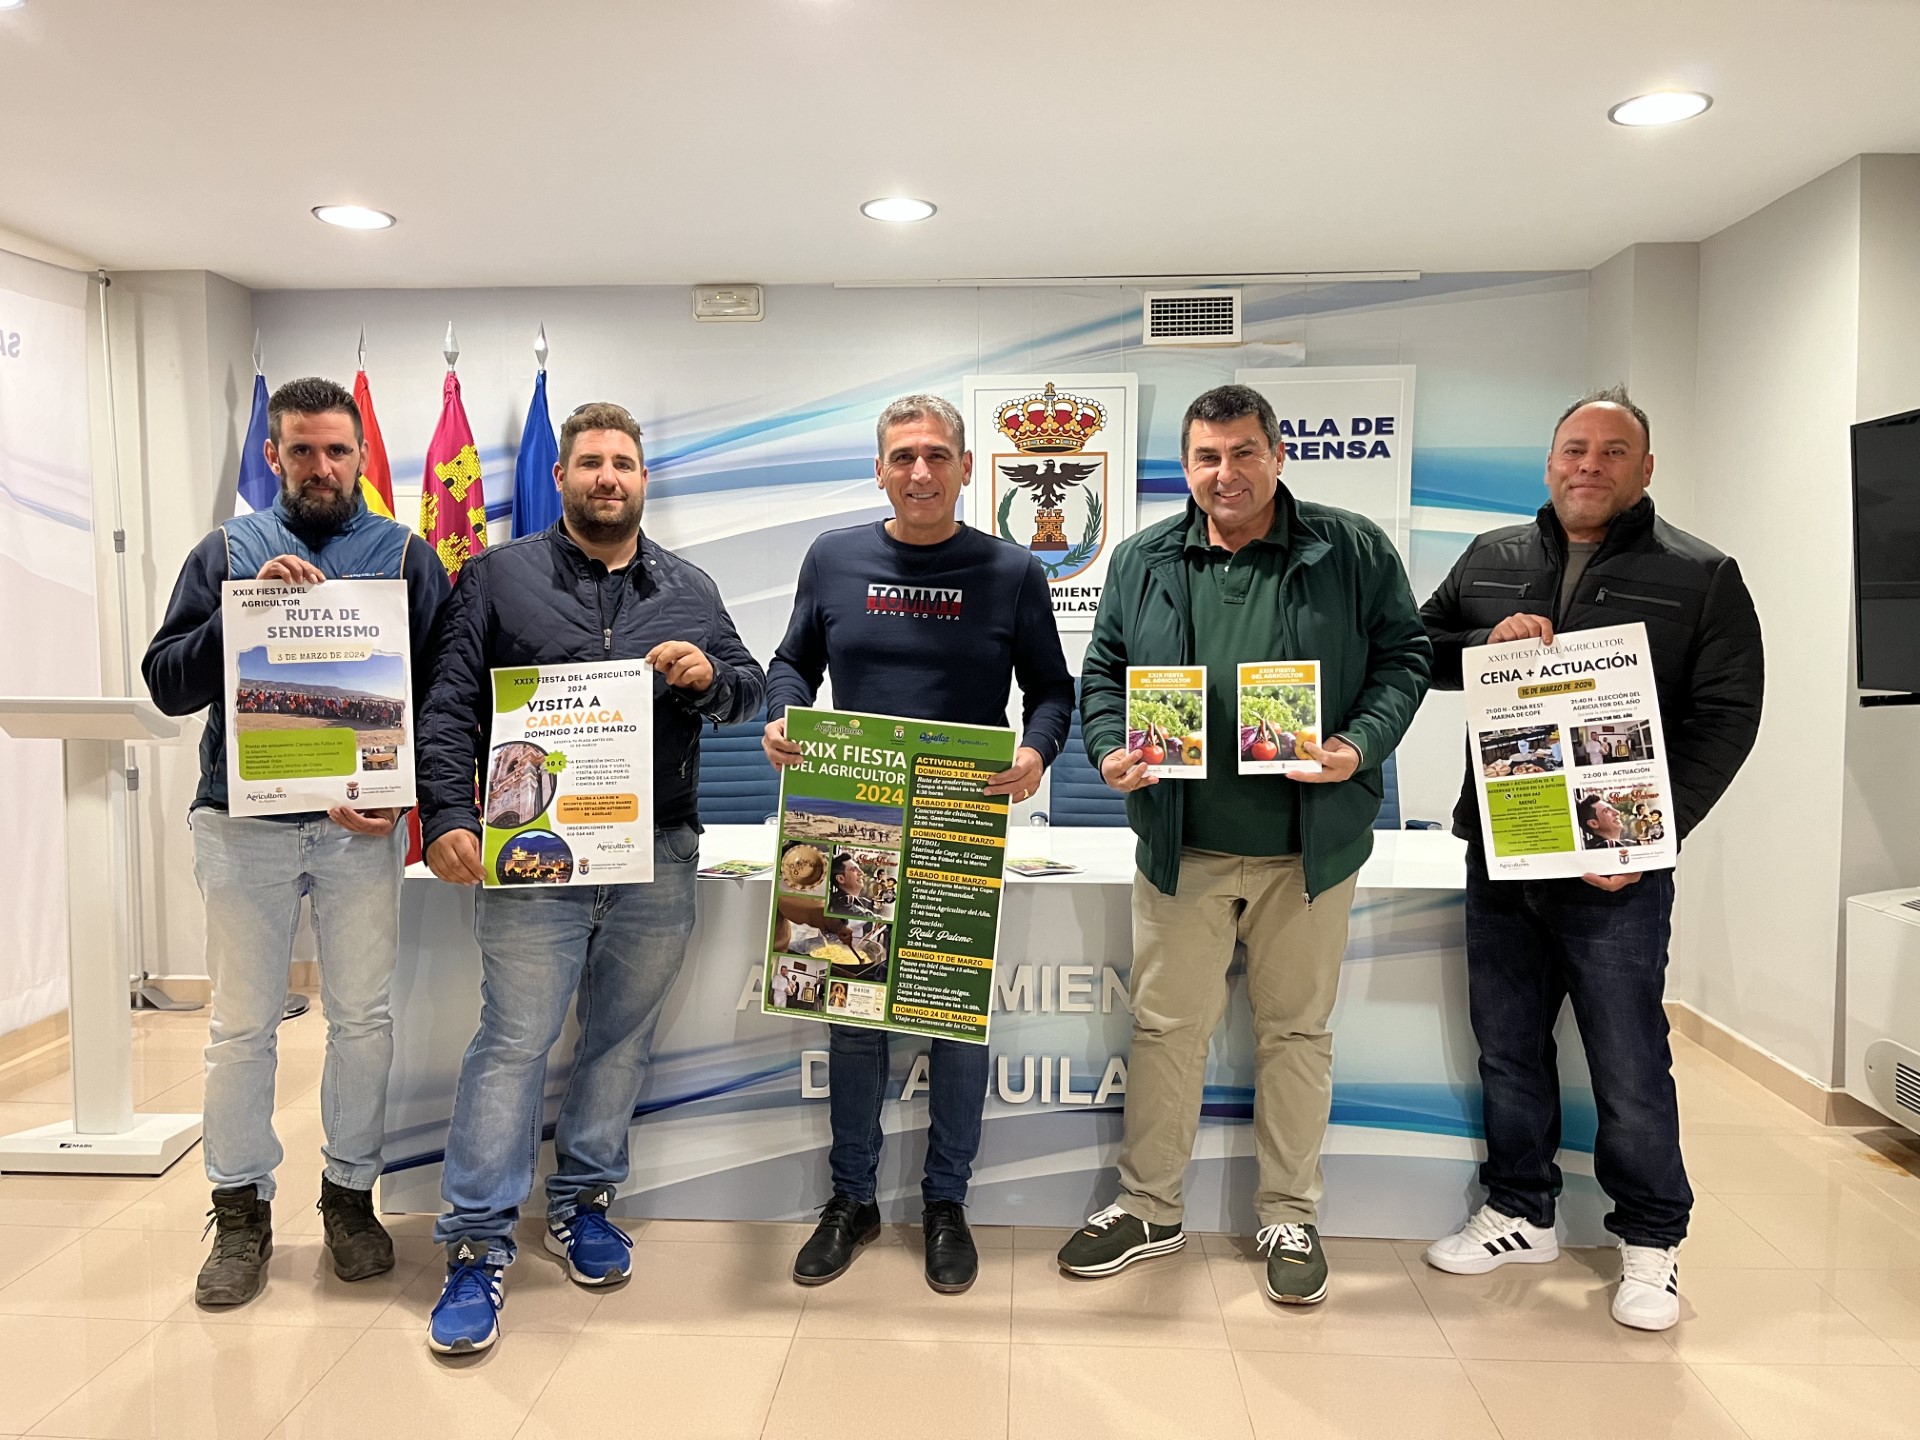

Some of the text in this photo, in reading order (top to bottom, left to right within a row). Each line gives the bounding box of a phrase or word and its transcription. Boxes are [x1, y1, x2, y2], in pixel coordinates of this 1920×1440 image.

[1279, 417, 1394, 437] ALA DE
[1285, 440, 1391, 461] RENSA
[241, 599, 300, 608] AGRICULTOR
[872, 586, 959, 613] TOMMY
[1052, 602, 1098, 611] UILAS
[286, 608, 360, 621] RUTA DE
[267, 626, 380, 638] SENDERISMO
[1488, 638, 1624, 663] XXIX FIESTA DEL AGRICULTOR
[1480, 652, 1638, 685] CENA + ACTUACIÓN
[514, 678, 534, 686] XXIX
[586, 670, 640, 680] AGRICULTOR
[1540, 685, 1561, 693] MARZO
[1598, 692, 1628, 701] ELECCIÓN
[527, 696, 601, 713] VISITA A
[1572, 702, 1613, 711] AGRICULTOR
[526, 710, 624, 729] CARAVACA
[524, 728, 571, 739] DOMINGO
[843, 745, 907, 769] FIESTA
[916, 757, 975, 768] ACTIVIDADES
[818, 762, 906, 785] AGRICULTOR
[918, 768, 952, 777] DOMINGO
[1612, 767, 1650, 776] ACTUACIÓN
[855, 783, 904, 806] 2024
[913, 830, 947, 840] DOMINGO
[970, 836, 994, 845] MARZO
[911, 846, 934, 854] Marina
[944, 849, 961, 857] Cope
[909, 870, 939, 879] SÁBADO
[911, 902, 936, 910] Elección
[937, 905, 967, 914] Agricultor
[908, 927, 934, 940] Raúl
[901, 950, 934, 960] DOMINGO
[957, 957, 983, 966] MARZO
[914, 983, 942, 993] Concurso
[896, 1006, 928, 1016] DOMINGO
[952, 1013, 977, 1022] MARZO
[895, 1015, 910, 1023] Viaje
[916, 1018, 944, 1027] Caravaca
[802, 1051, 830, 1099] D
